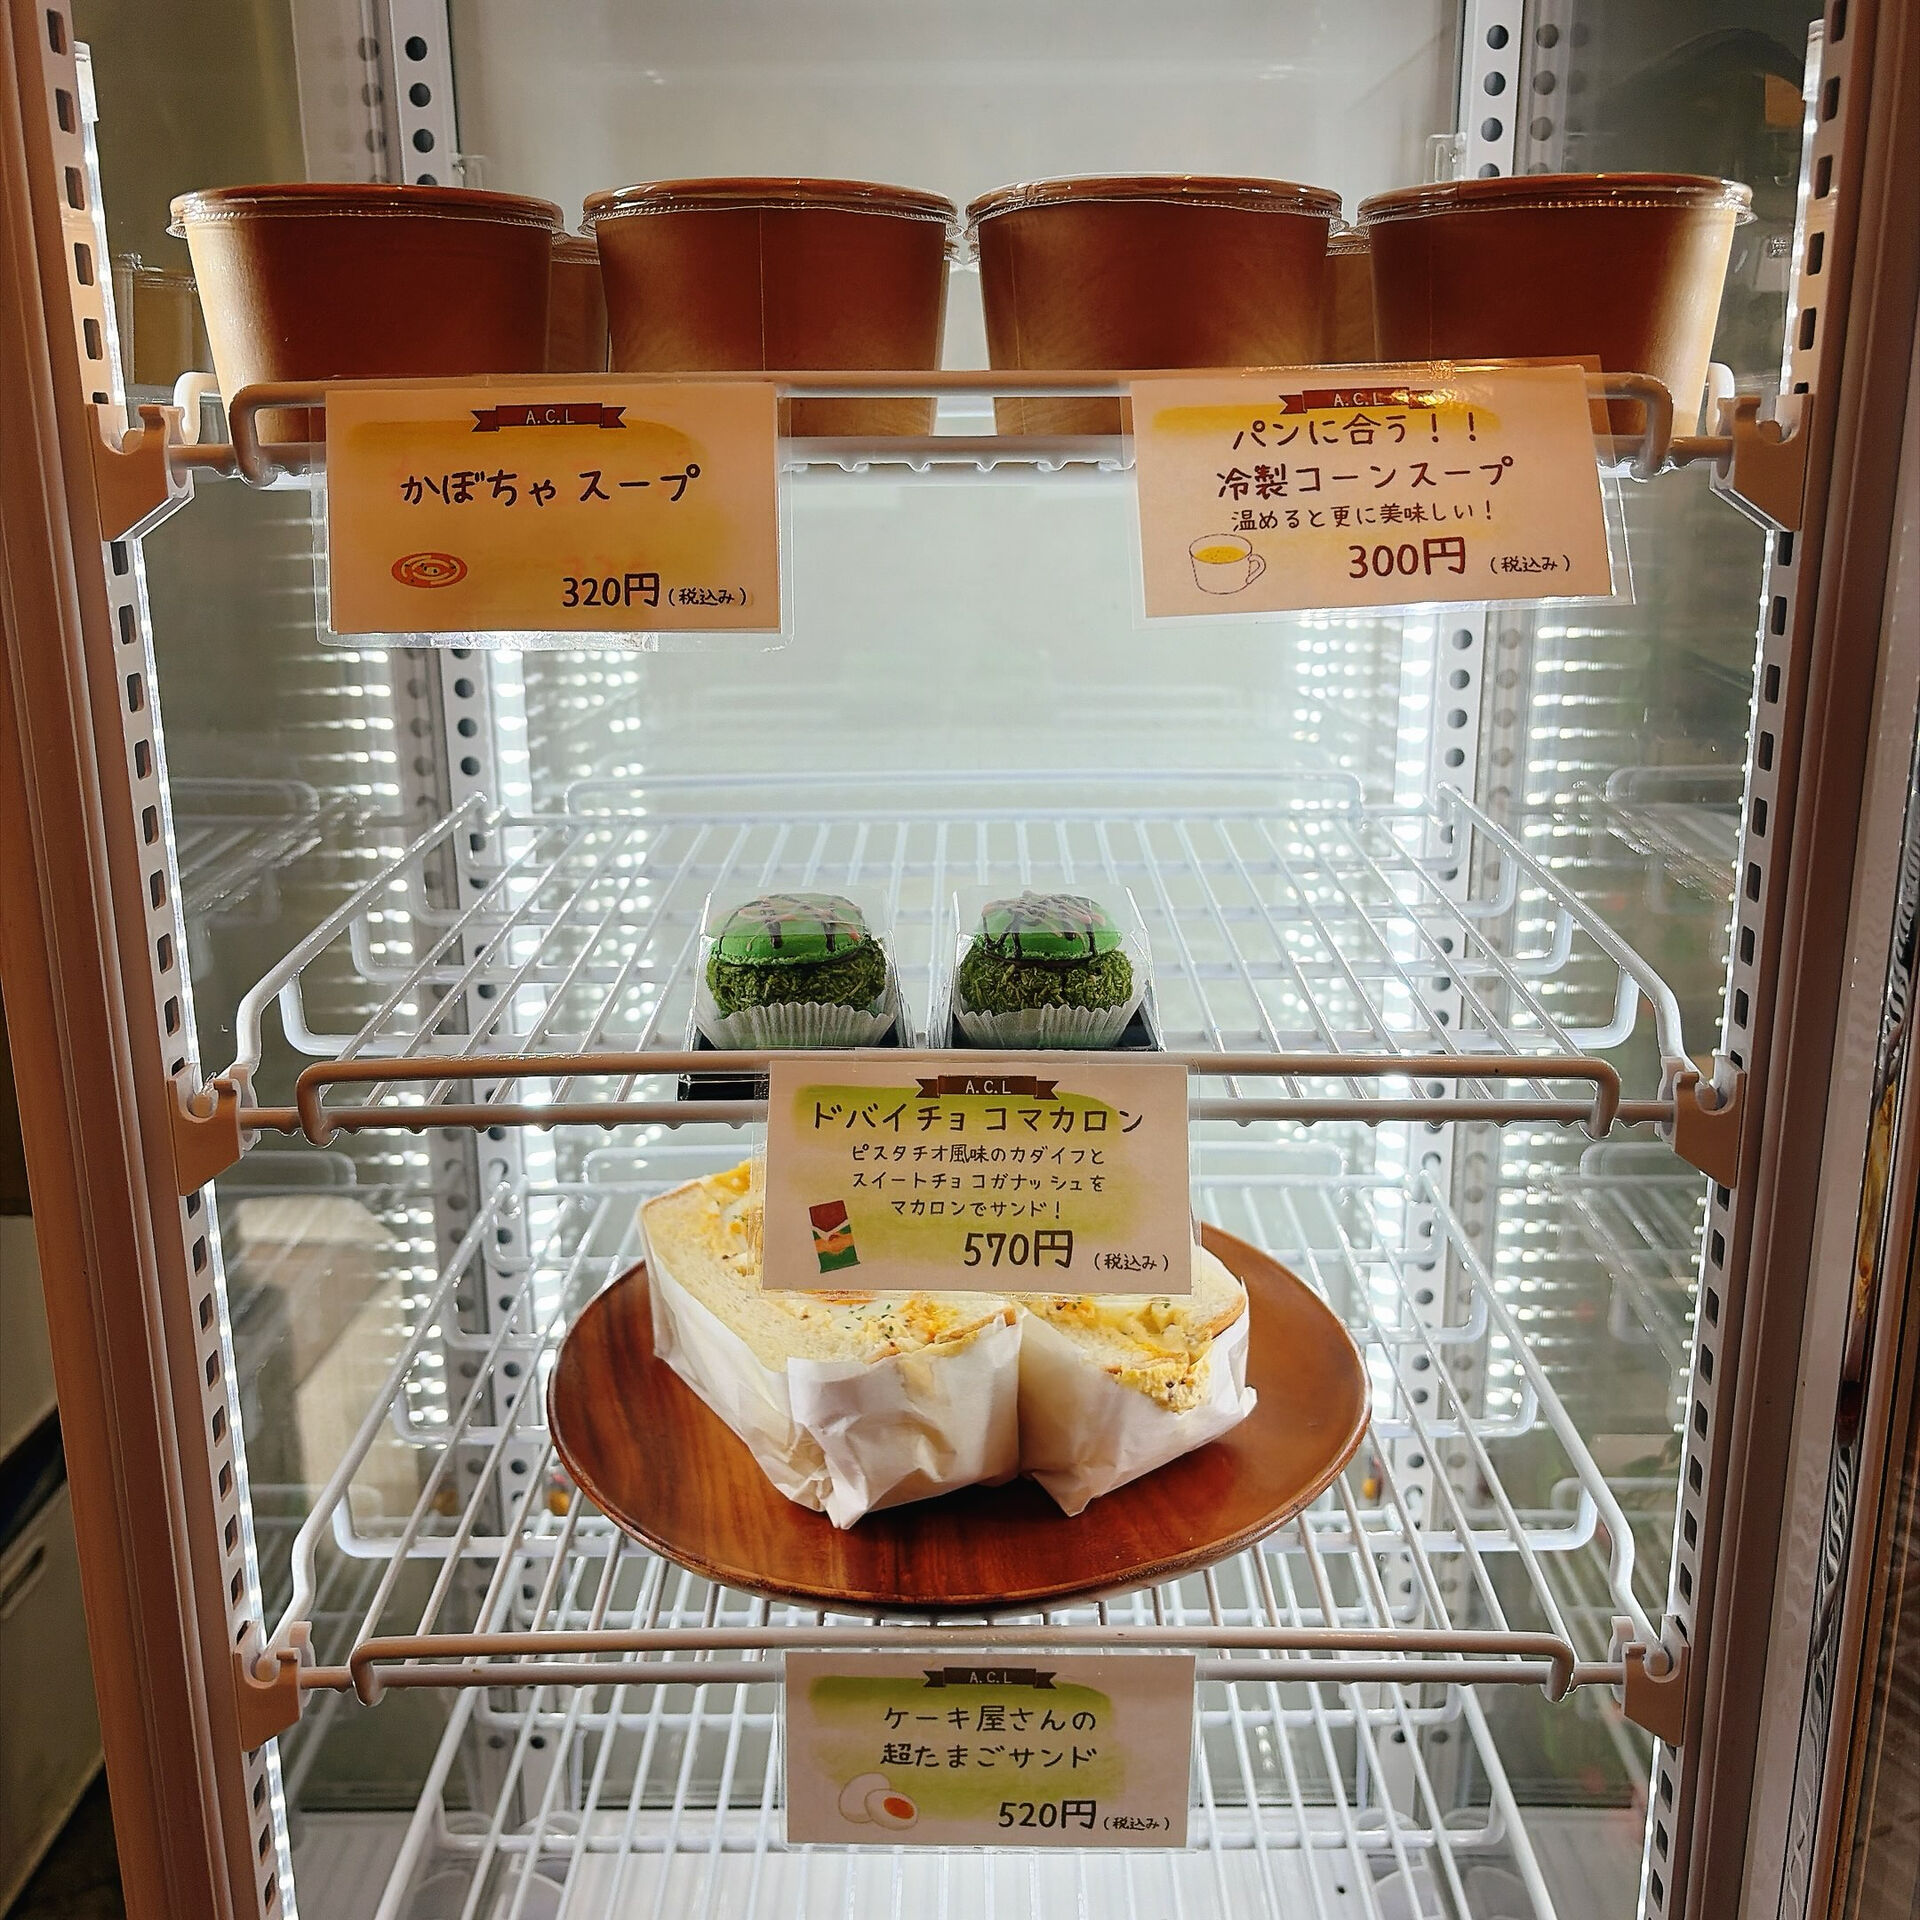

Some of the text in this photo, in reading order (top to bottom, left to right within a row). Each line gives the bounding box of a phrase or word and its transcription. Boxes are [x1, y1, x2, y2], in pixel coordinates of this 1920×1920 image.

[1333, 392, 1385, 408] A.C.L
[525, 408, 576, 426] A.C.L
[1232, 412, 1476, 450] パンに合う！！
[1216, 455, 1514, 500] 冷製コーンスープ
[1231, 499, 1493, 532] 温めると更に美味しい！
[1348, 536, 1465, 580] 300円
[562, 572, 660, 608] 320円
[965, 1080, 1011, 1095] A.C.L
[852, 1144, 1104, 1165] ピスタチオ風味のカダイフと
[891, 1200, 1061, 1218] マカロンでサンド！
[963, 1229, 1073, 1269] 570円
[969, 1671, 1012, 1685] A.C.L
[884, 1705, 1096, 1733] ケーキ屋さんの
[880, 1743, 1097, 1769] 超たまごサンド
[998, 1800, 1097, 1830] 520円
